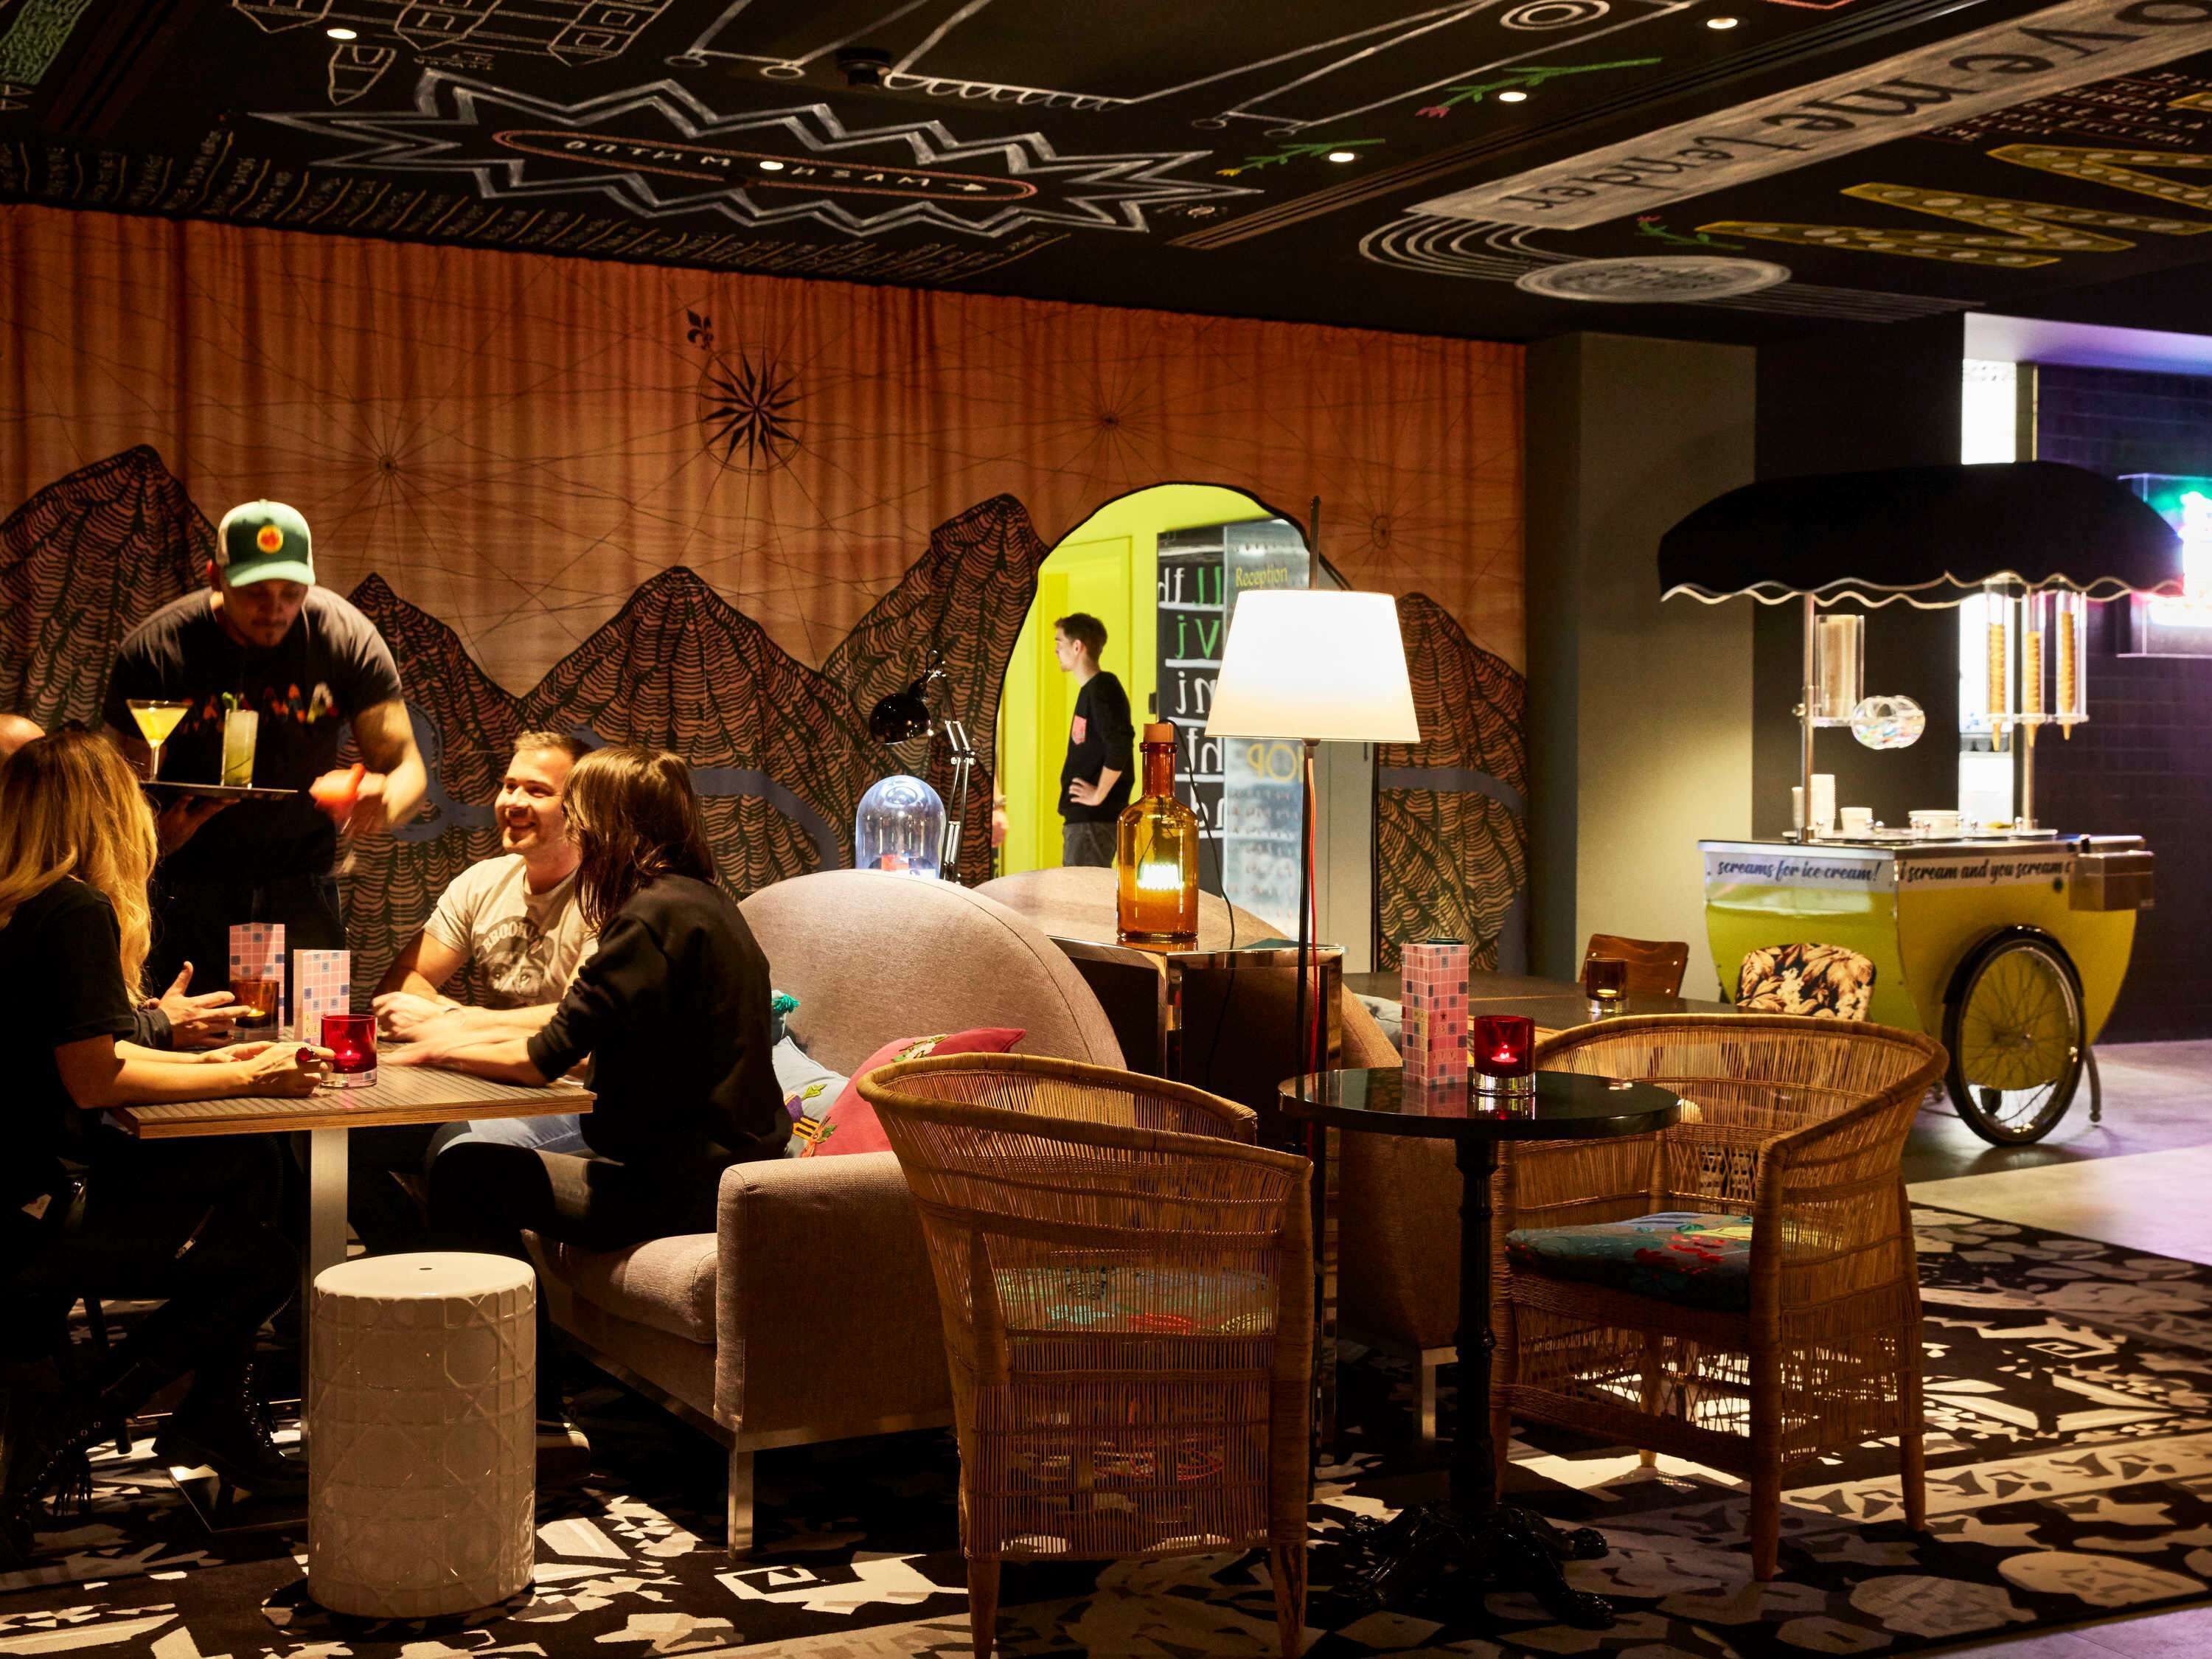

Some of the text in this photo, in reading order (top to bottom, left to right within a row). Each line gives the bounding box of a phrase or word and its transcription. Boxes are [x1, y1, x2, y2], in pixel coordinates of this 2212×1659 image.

[1235, 566, 1287, 588] Reception
[1717, 860, 1882, 882] screams for ice cream!
[1908, 866, 1957, 883] scream
[1961, 858, 1990, 878] and
[1990, 863, 2014, 884] you
[2016, 860, 2063, 878] scream
